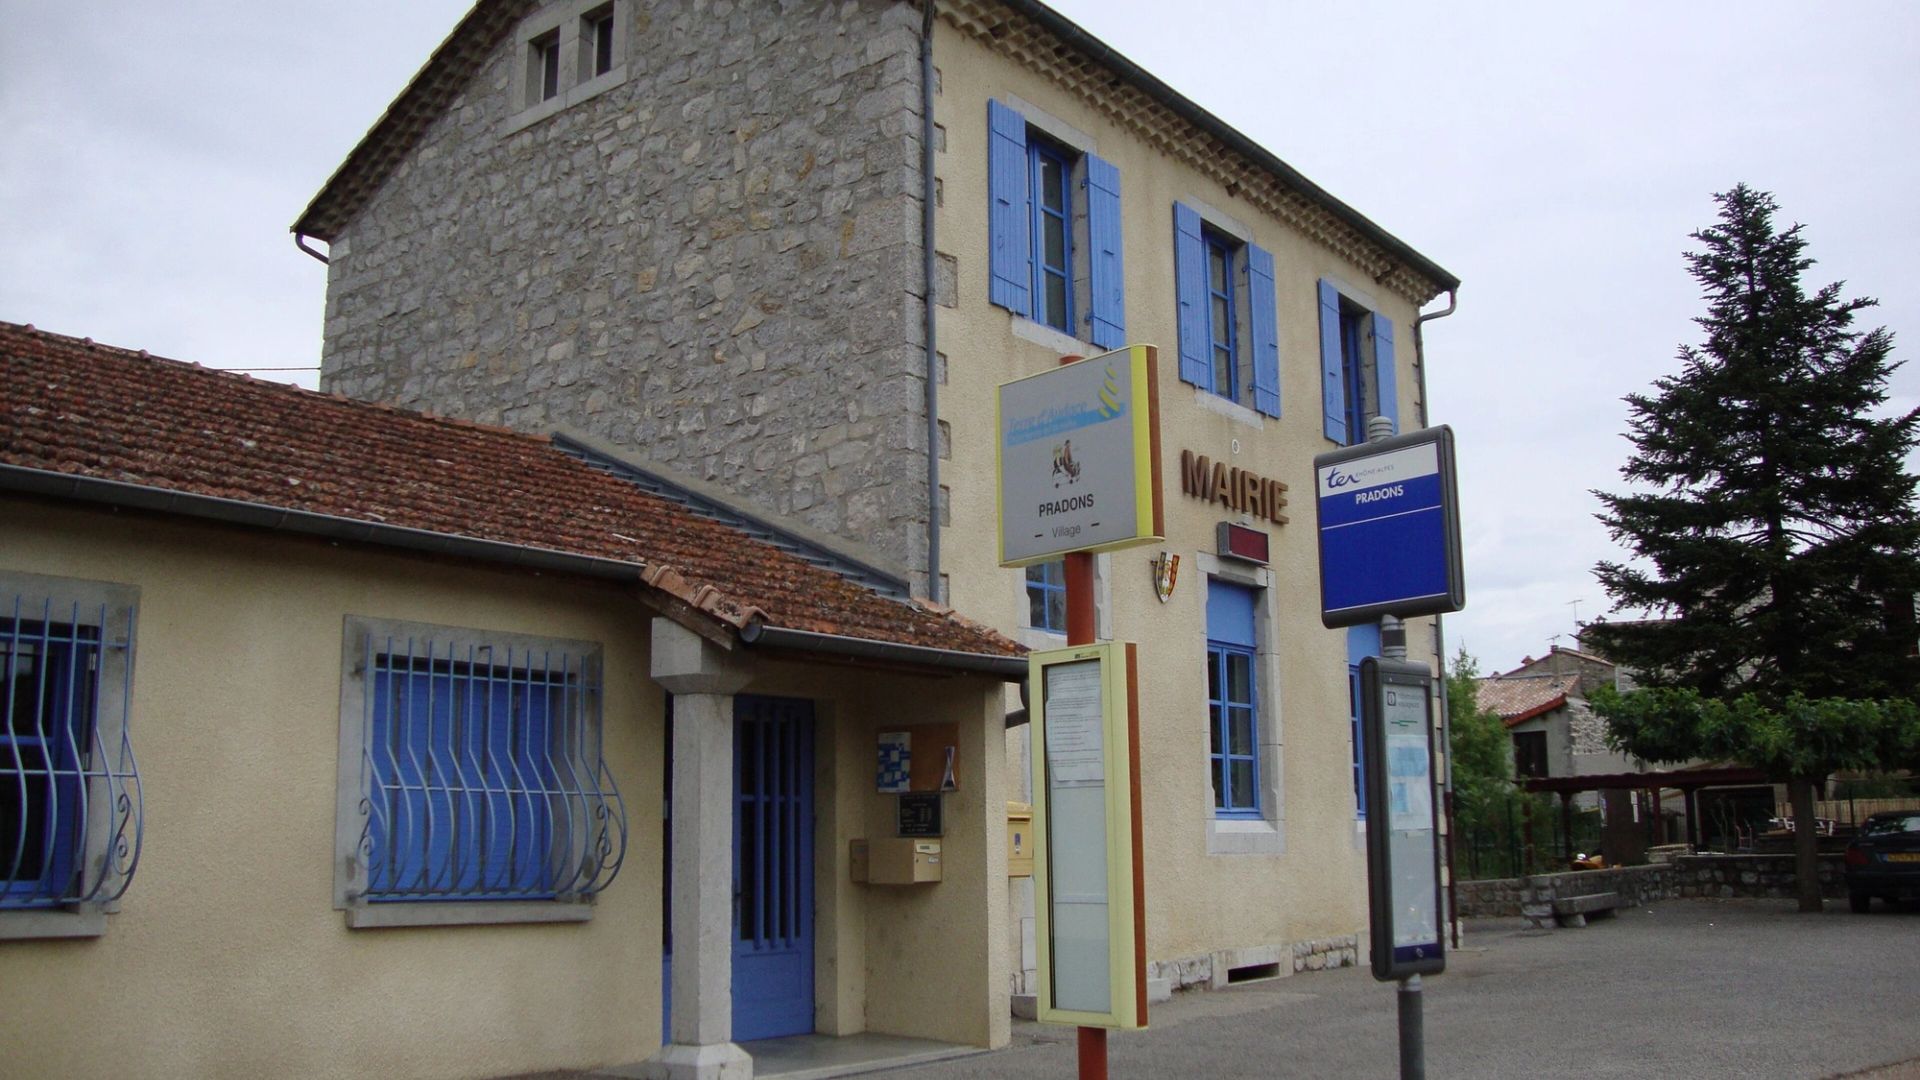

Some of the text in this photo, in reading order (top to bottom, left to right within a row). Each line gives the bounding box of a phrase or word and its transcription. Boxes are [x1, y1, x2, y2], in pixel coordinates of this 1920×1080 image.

[1182, 449, 1290, 525] MAIRIE
[1326, 467, 1361, 489] ter
[1039, 493, 1094, 518] PRADONS
[1355, 484, 1405, 505] PRADONS
[1052, 525, 1081, 540] Village
